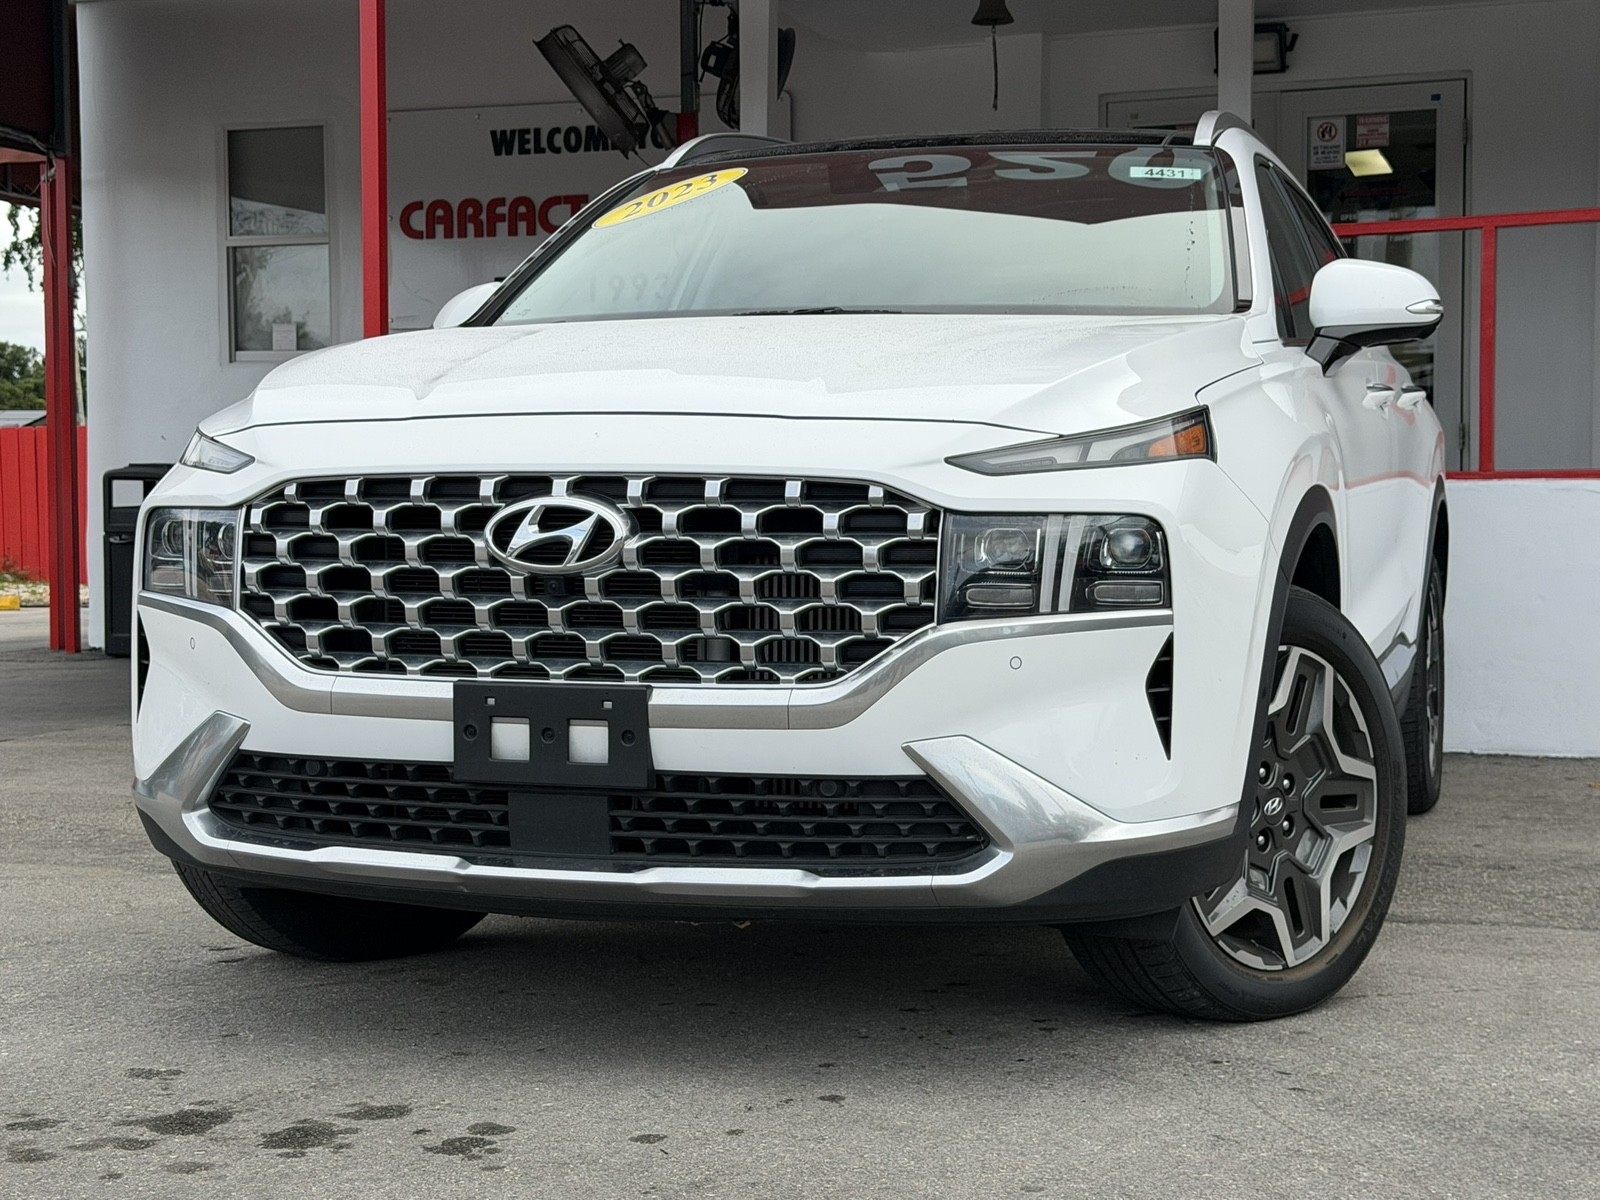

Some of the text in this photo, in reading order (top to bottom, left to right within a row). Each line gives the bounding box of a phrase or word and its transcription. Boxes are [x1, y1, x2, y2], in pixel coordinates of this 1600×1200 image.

[491, 124, 621, 156] WELCOM
[1144, 168, 1185, 178] 4431
[622, 174, 718, 219] 2023
